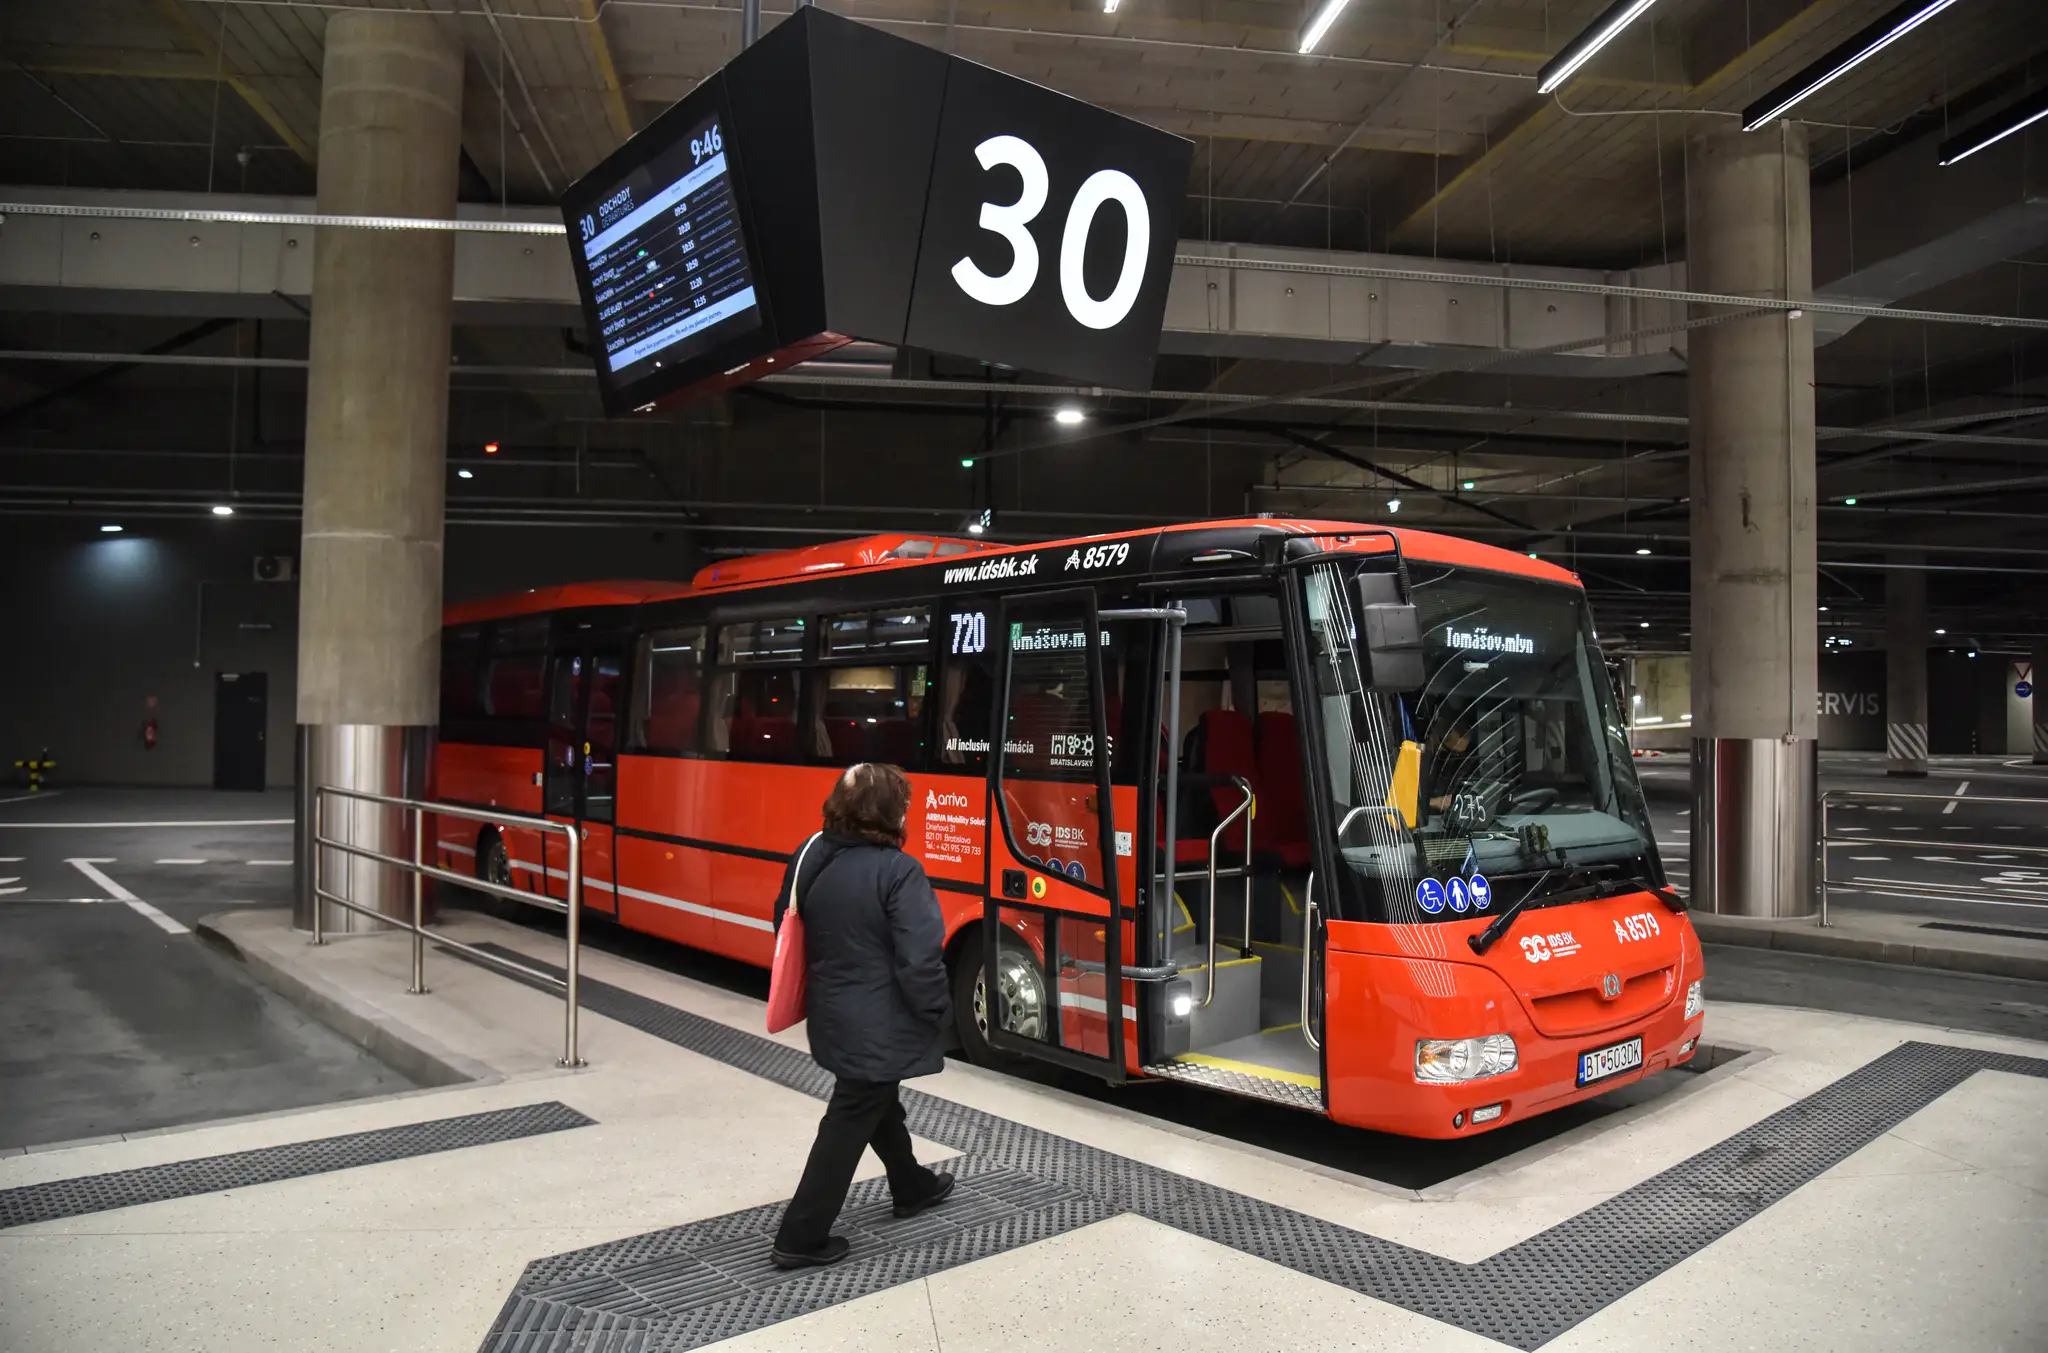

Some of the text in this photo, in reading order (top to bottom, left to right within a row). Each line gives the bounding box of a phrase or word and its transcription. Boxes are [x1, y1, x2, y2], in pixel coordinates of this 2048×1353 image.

[690, 124, 721, 165] 9:46
[599, 186, 631, 217] ODCHODY
[601, 198, 635, 229] DEPARTURES
[580, 214, 595, 240] 30
[951, 135, 1150, 330] 30
[944, 554, 1039, 584] www.idsbk.sk
[1083, 543, 1130, 569] 8579
[951, 612, 986, 654] 720
[1012, 628, 1110, 650] omášov,mn
[946, 738, 1034, 754] All inclusive stinácia
[1050, 758, 1094, 767] BRATISLAVSKÝ
[938, 792, 968, 807] arriva
[1456, 794, 1486, 823] 275
[926, 813, 946, 822] ARRIVA
[947, 814, 969, 826] Mobility
[949, 824, 956, 833] 31
[944, 834, 971, 844] Bratislava
[1055, 826, 1085, 841] IDS BK
[1546, 930, 1577, 948] IDS BK
[1624, 911, 1661, 941] 8579
[1586, 1040, 1640, 1078] BT 503DK
